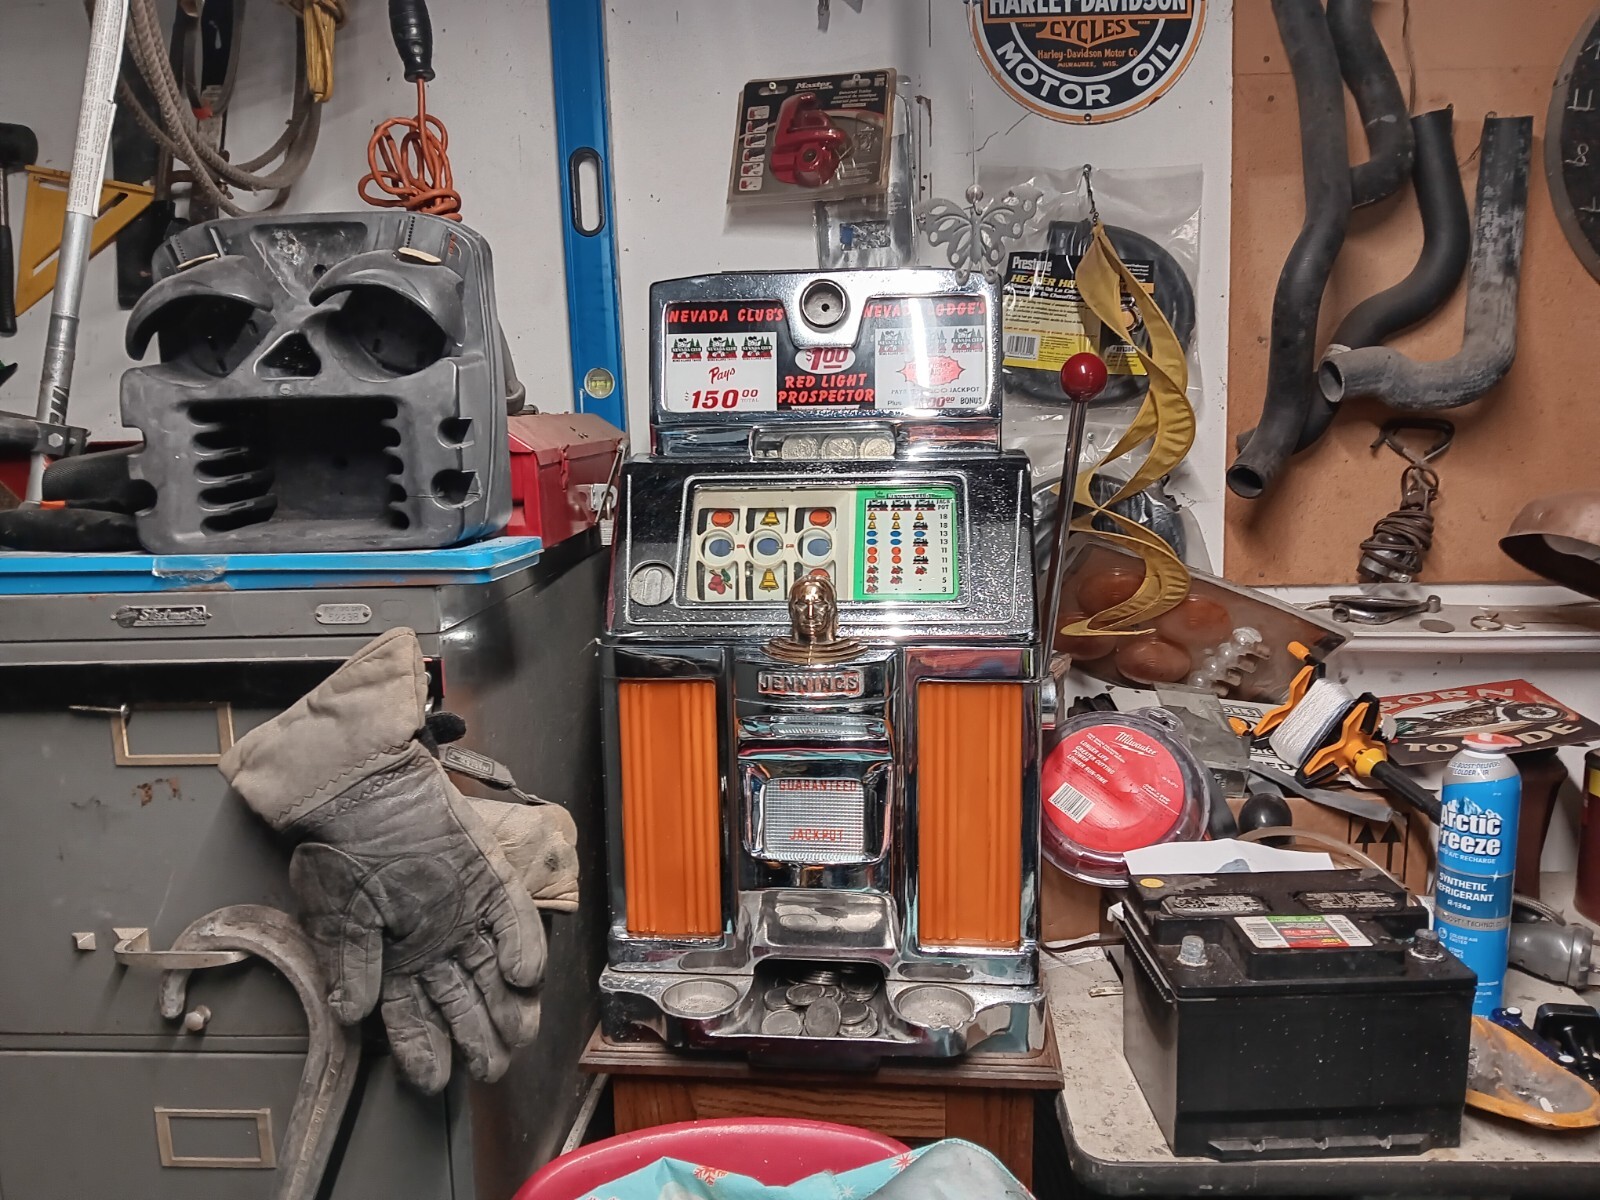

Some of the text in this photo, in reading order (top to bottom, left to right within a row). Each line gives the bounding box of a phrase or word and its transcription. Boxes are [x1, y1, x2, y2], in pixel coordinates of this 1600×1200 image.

[1050, 19, 1127, 44] CYCLES
[1037, 49, 1103, 61] Harley-Davidson
[1104, 48, 1126, 58] Motor
[996, 41, 1180, 106] MOTOR OIL
[1012, 256, 1052, 271] Prestone
[1058, 279, 1078, 289] HO
[669, 308, 785, 323] NEVADA CLUB'S
[863, 304, 911, 319] NEVAD
[708, 366, 736, 385] Pays
[785, 373, 867, 388] RED LIGHT
[777, 388, 875, 404] PROSPECTOR
[960, 396, 983, 405] BONUS
[759, 674, 859, 691] JENNINGS
[1380, 687, 1515, 713] BORN
[1115, 731, 1158, 755] Milwaukee
[1403, 722, 1583, 753] TO DE
[1095, 759, 1116, 775] CUTTING
[779, 780, 857, 791] GUARANTEED
[1441, 804, 1502, 836] Arctic
[789, 828, 845, 841] JACKPOT
[1460, 855, 1496, 864] RECHARGE
[1439, 872, 1488, 891] SYNTHETIC
[1437, 881, 1495, 902] REFRIGERANT
